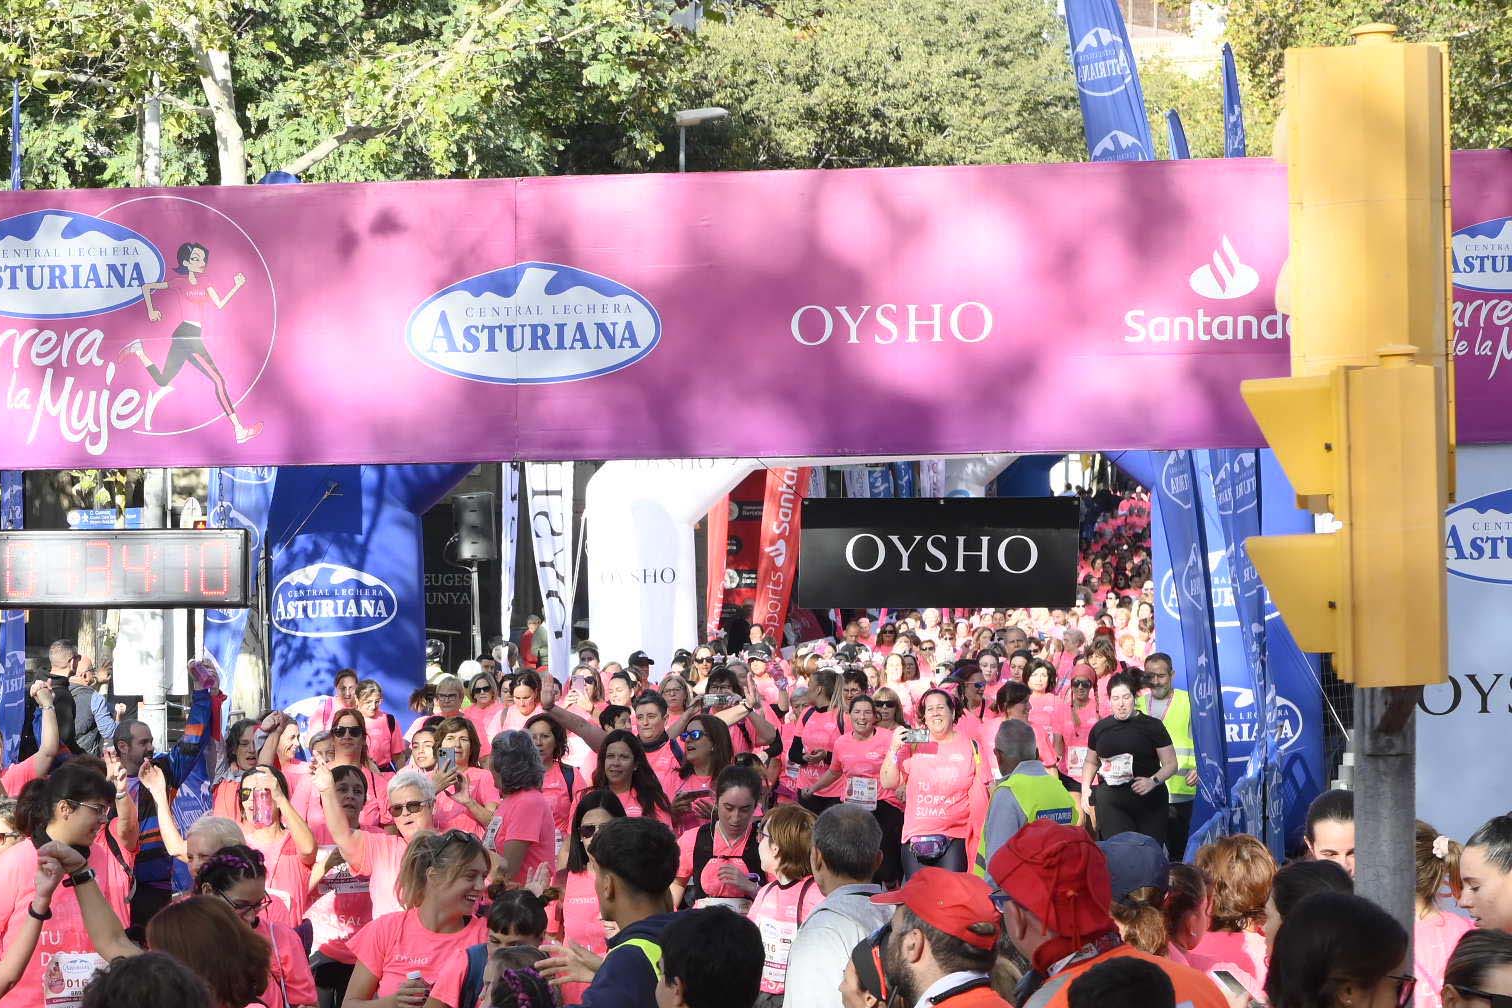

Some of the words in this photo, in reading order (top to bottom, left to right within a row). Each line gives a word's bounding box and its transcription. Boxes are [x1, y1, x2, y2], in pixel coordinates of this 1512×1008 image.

[67, 245, 140, 258] LECHERA
[465, 304, 544, 318] CENTRAL
[552, 302, 634, 316] LECHERA
[428, 310, 642, 354] ASTURIANA
[790, 301, 993, 345] OYSHO
[7, 371, 32, 411] la
[26, 362, 175, 457] Mujer
[845, 532, 1039, 574] OYSHO
[600, 567, 676, 585] OYSHO
[287, 589, 329, 597] CENTRAL
[335, 588, 384, 597] LECHERA
[275, 594, 389, 621] ASTURIANA
[41, 930, 61, 945] TU
